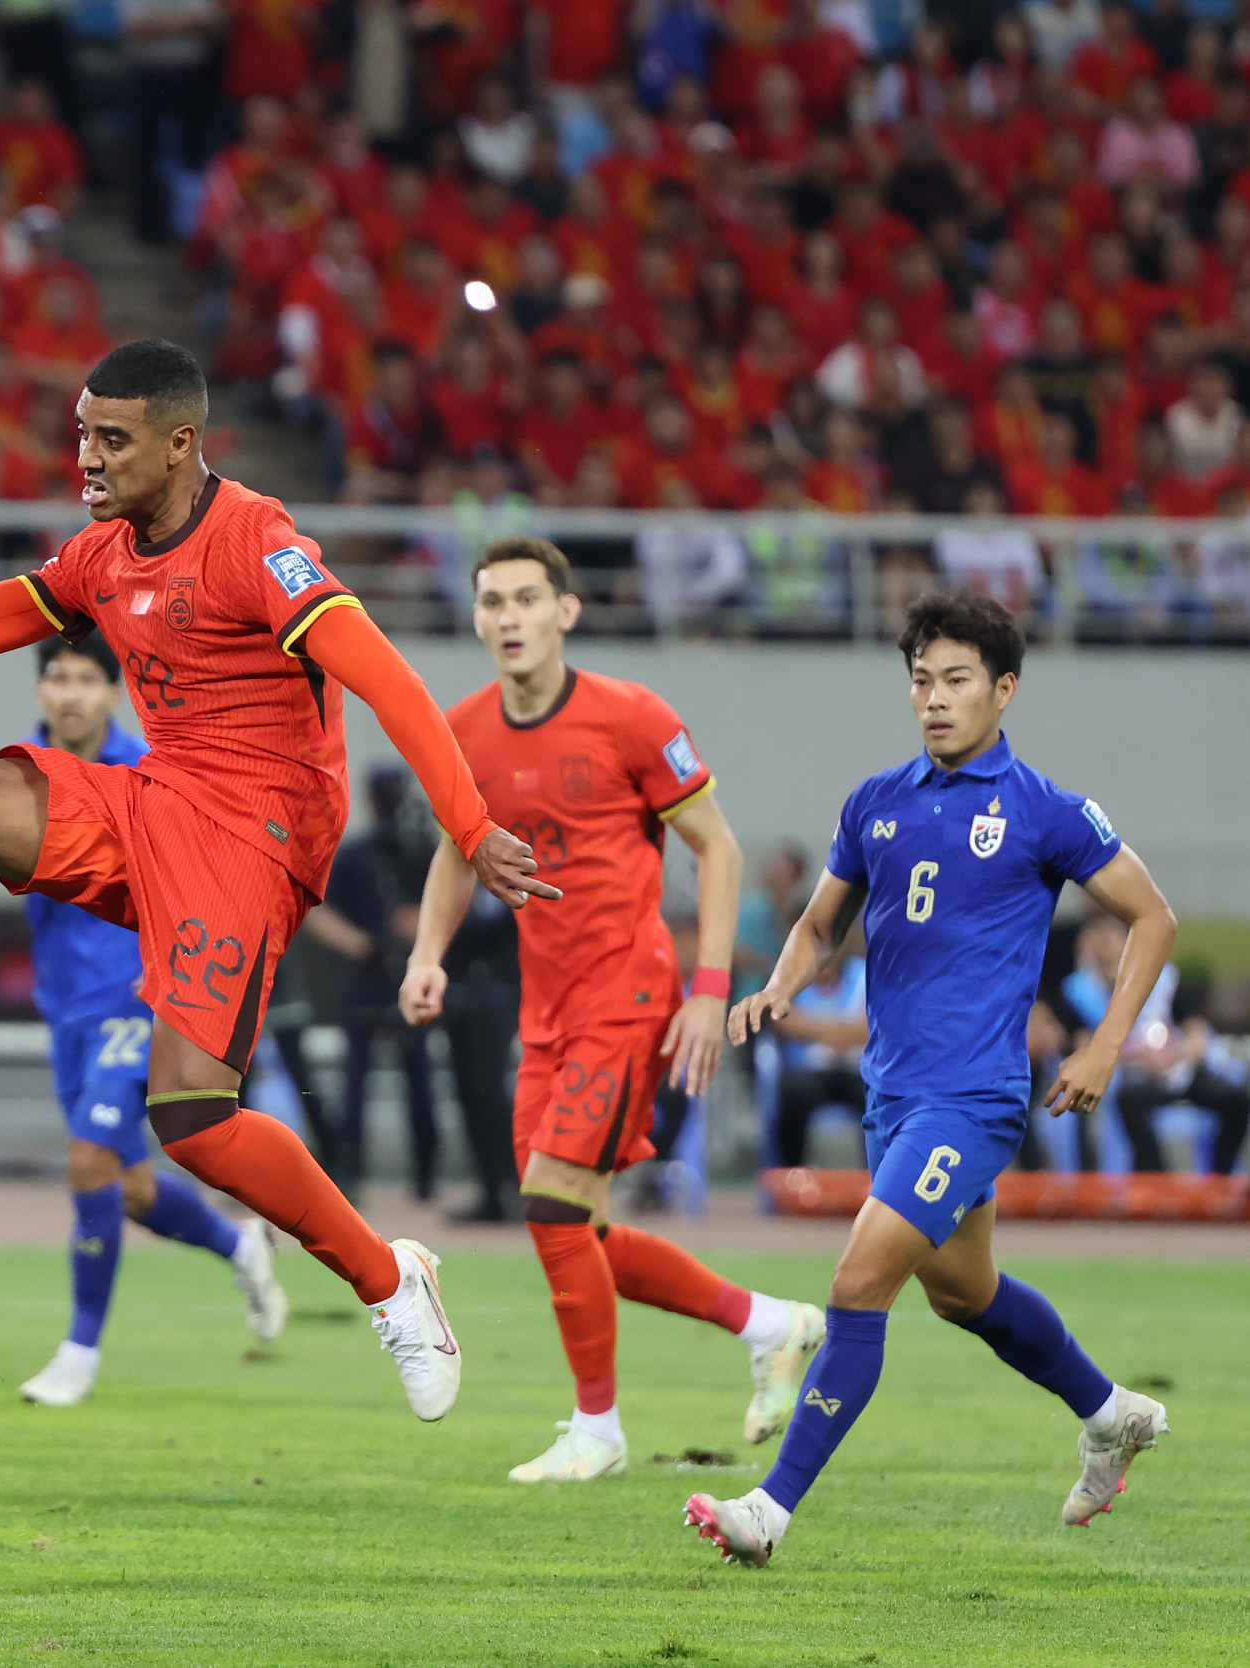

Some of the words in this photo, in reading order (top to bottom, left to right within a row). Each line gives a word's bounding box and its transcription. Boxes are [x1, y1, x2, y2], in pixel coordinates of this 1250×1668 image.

[170, 581, 193, 591] CFA
[275, 552, 301, 565] FOOTBALL
[280, 558, 306, 573] UNITES
[127, 650, 185, 710] 22
[906, 860, 940, 924] 6
[169, 917, 246, 1005] 22
[97, 1016, 151, 1068] 22
[914, 1145, 961, 1203] 6
